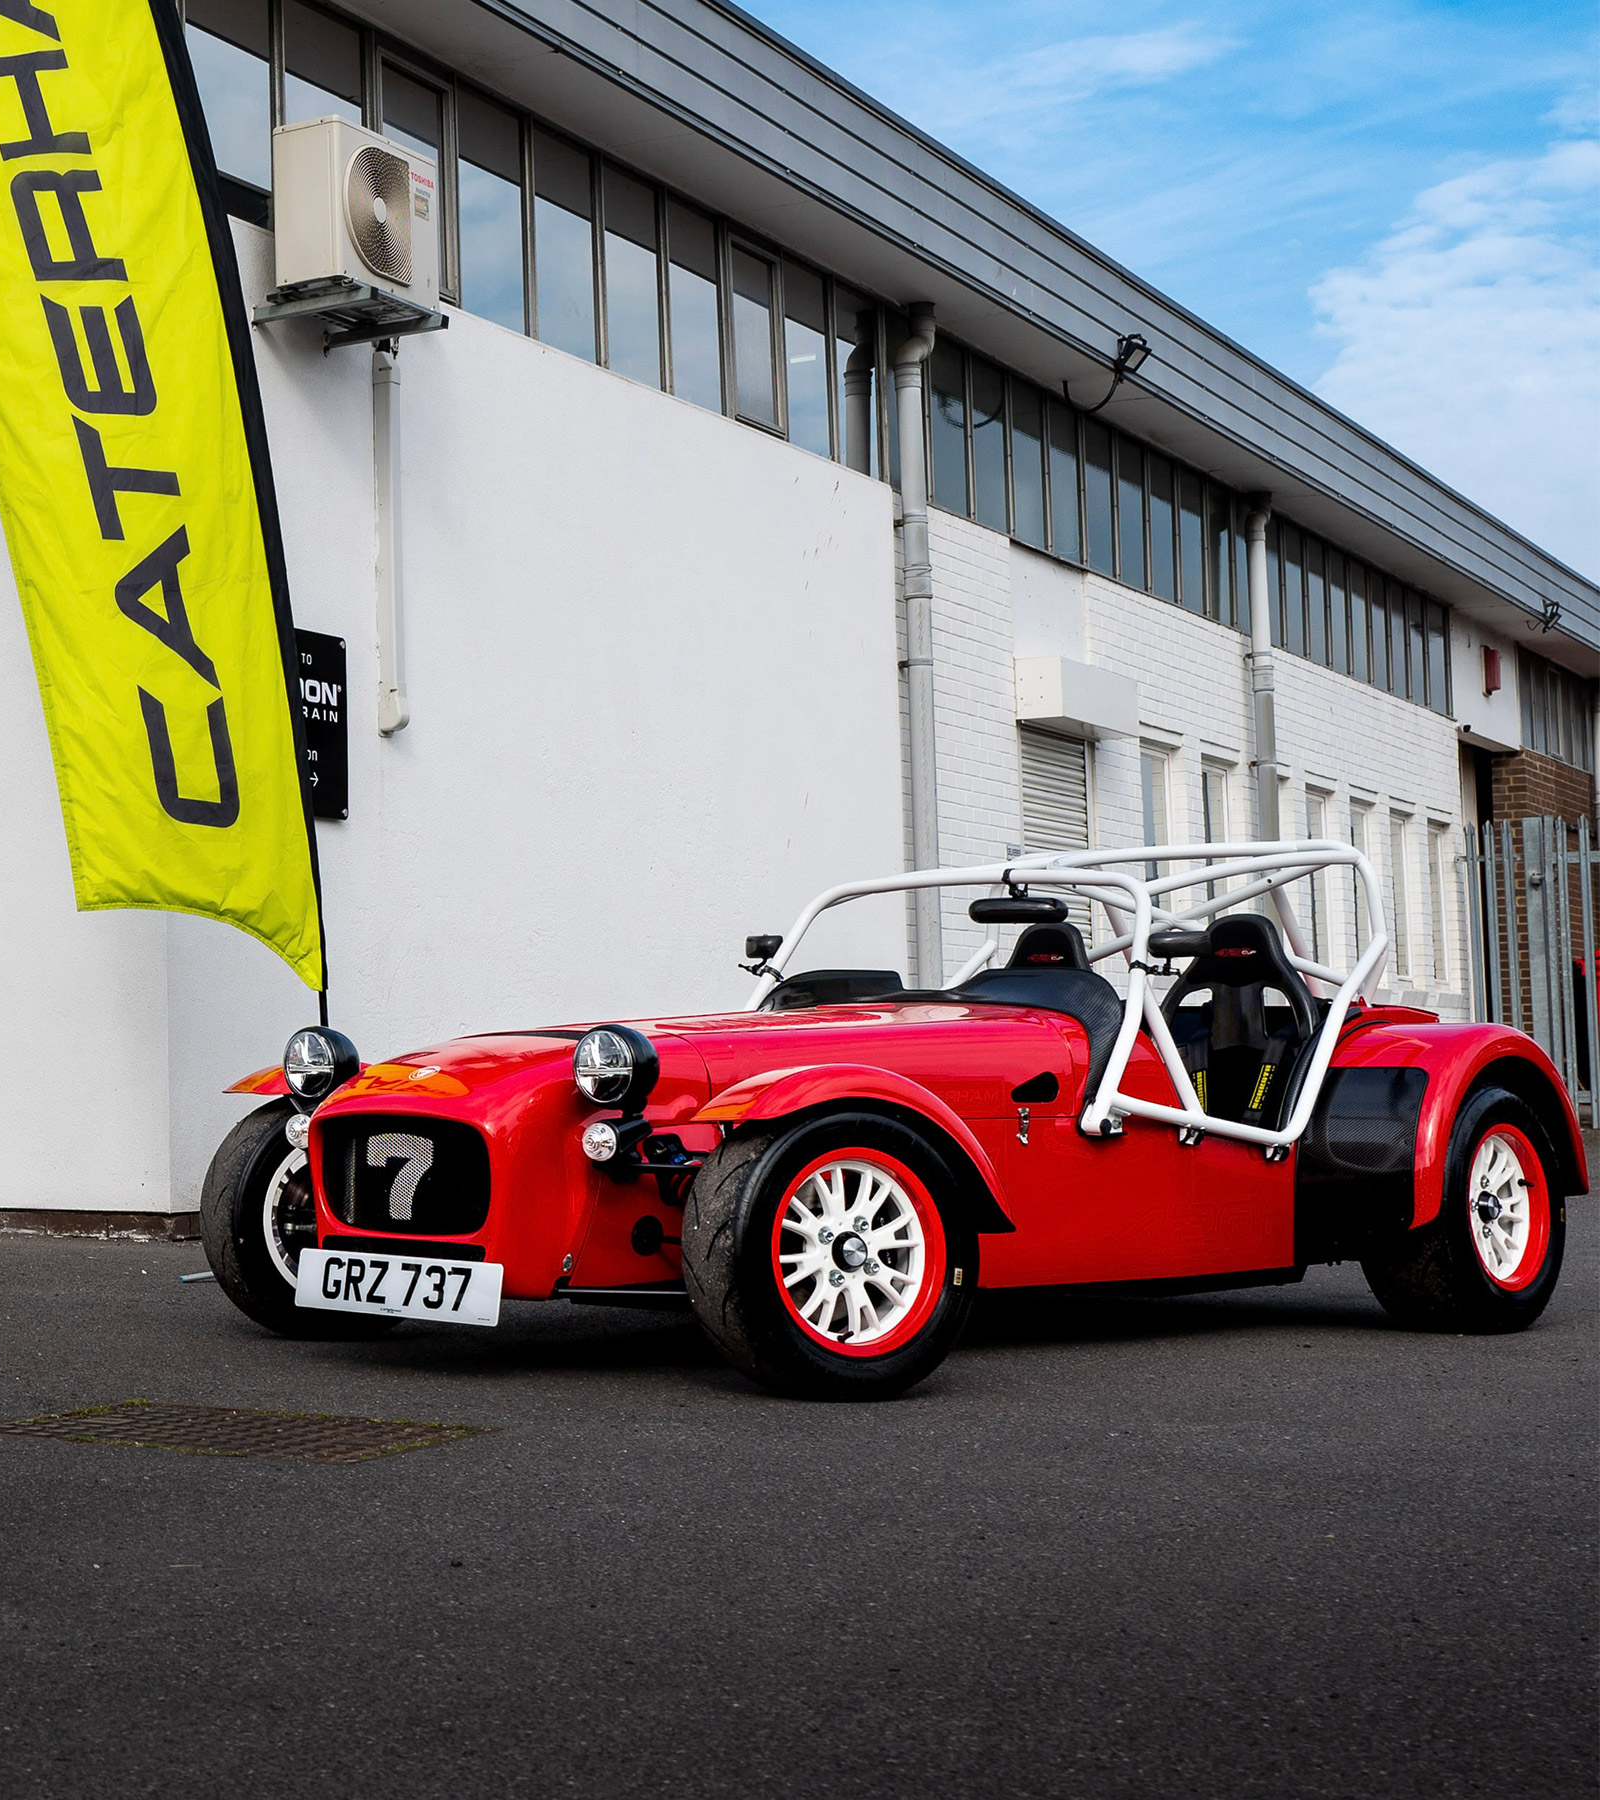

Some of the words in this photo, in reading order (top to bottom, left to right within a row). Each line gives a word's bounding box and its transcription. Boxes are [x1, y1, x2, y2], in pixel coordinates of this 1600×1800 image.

[410, 170, 434, 189] TOSHIBA
[301, 653, 312, 665] TO
[367, 1133, 434, 1220] 7
[322, 1256, 390, 1305] GRZ
[401, 1262, 473, 1312] 737
